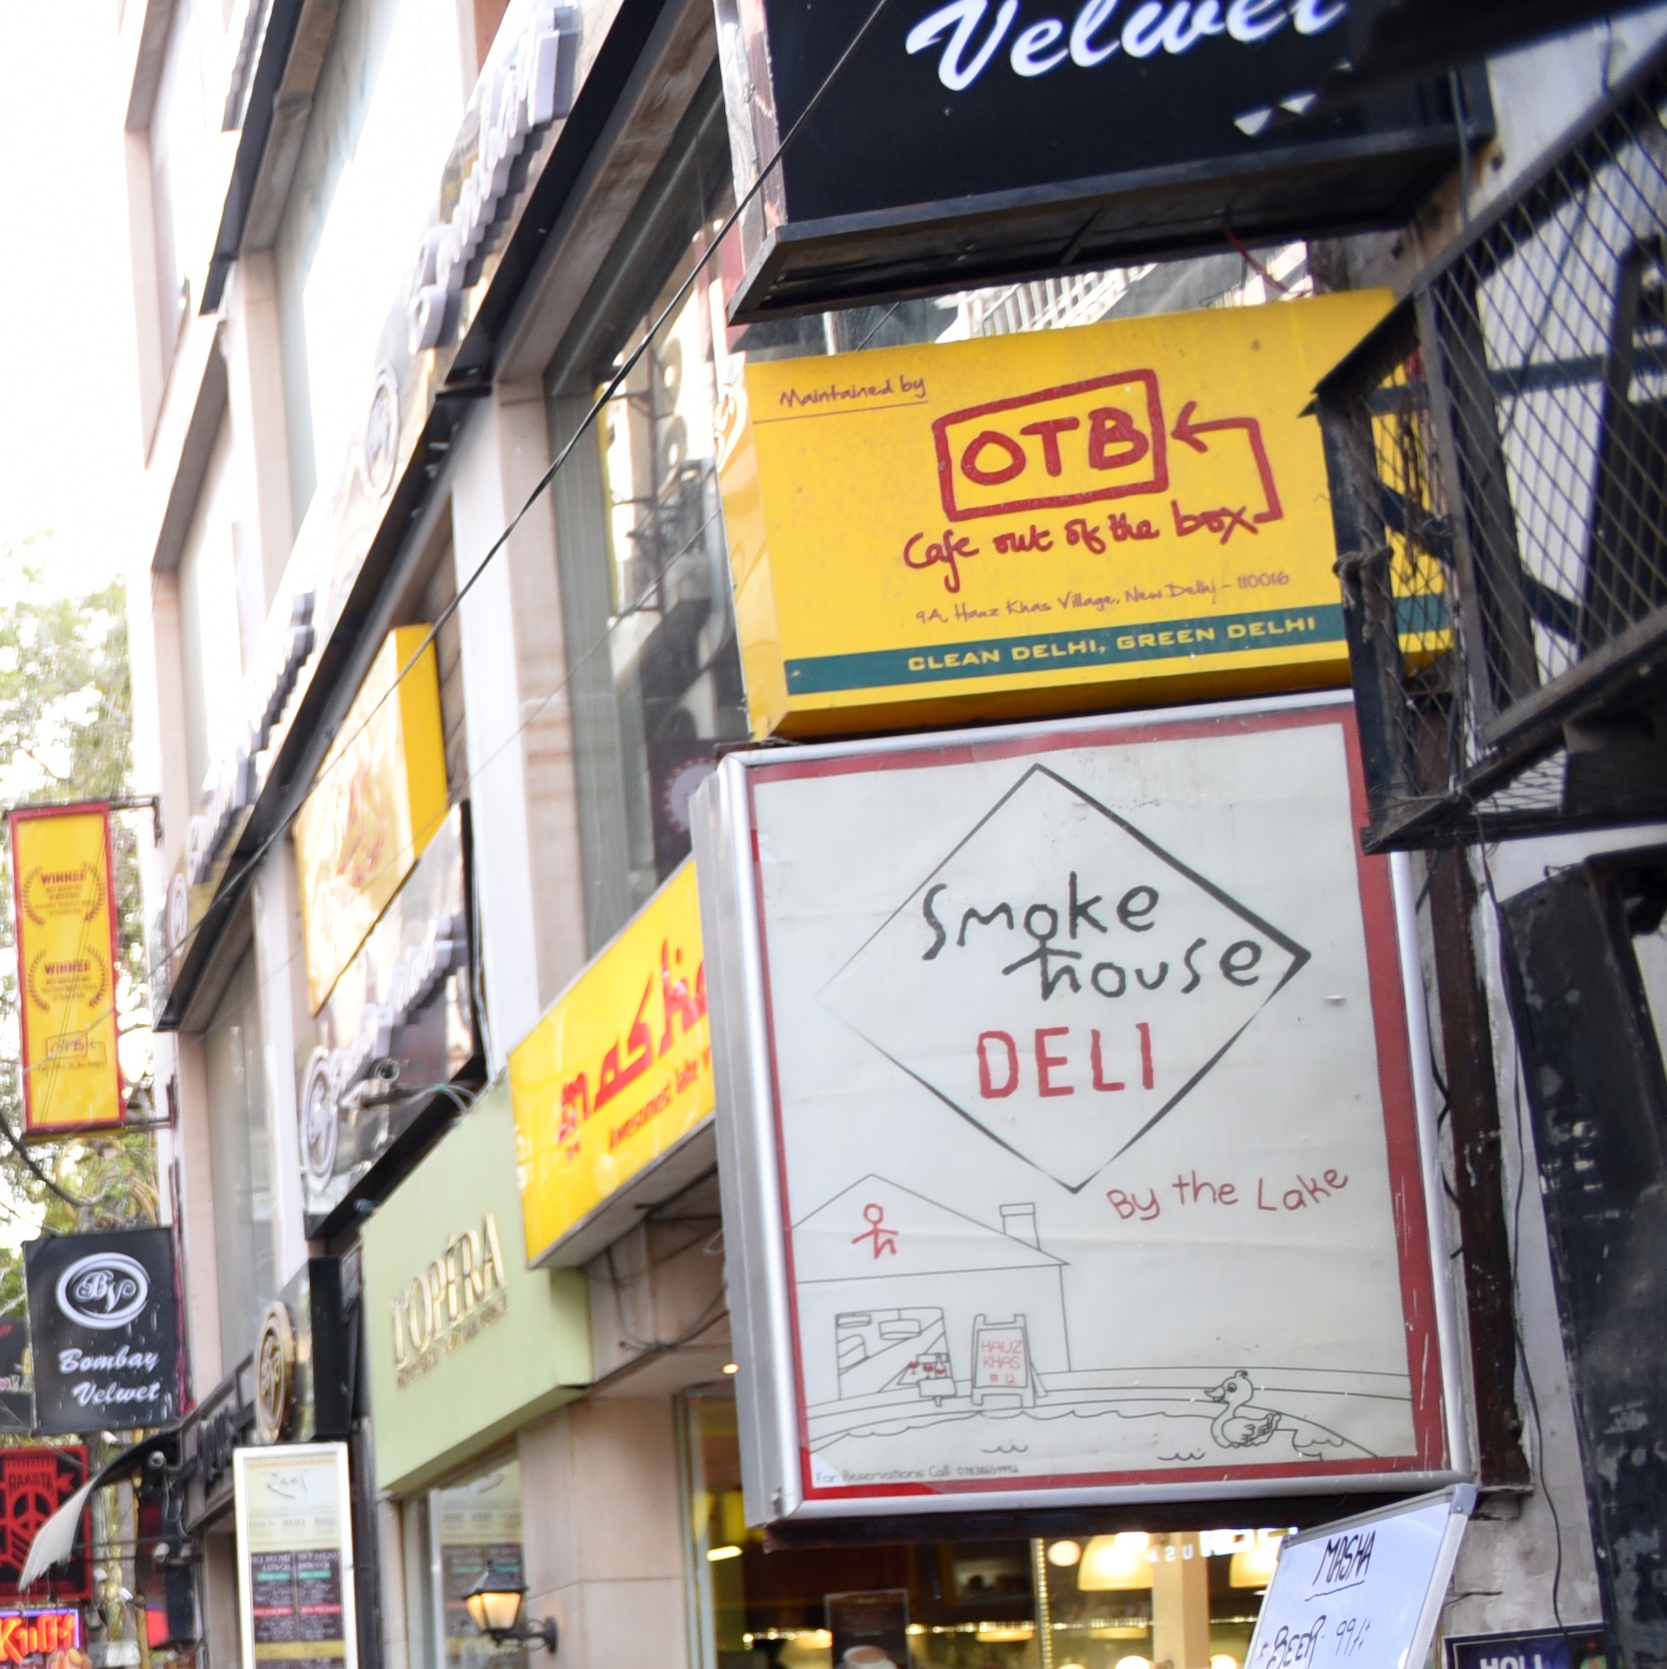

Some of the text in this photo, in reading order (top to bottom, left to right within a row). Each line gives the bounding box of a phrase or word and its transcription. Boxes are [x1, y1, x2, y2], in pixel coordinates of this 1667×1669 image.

[779, 374, 928, 408] Maintained by
[960, 406, 1150, 486] OTB
[903, 499, 1259, 593] Cafe out of the box
[953, 602, 1001, 623] Hauz
[1006, 596, 1053, 618] Khas
[1057, 588, 1120, 612] Village,
[1124, 583, 1163, 602] New
[1163, 579, 1217, 604] Delhi
[907, 615, 1317, 673] CLEAN DELHI, GREEN DELHI
[41, 870, 88, 885] WINNER
[921, 871, 1160, 960] Smoke
[44, 960, 92, 976] WINNER
[1002, 938, 1263, 1001] house
[977, 1022, 1155, 1099] DELI
[1105, 1167, 1349, 1221] By the Lake
[58, 1345, 160, 1374] Bombay
[981, 1339, 1023, 1355] HAUZ
[983, 1356, 1021, 1370] KHAS
[8, 1471, 54, 1497] RAASTA
[817, 1465, 950, 1484] For Reservations Call
